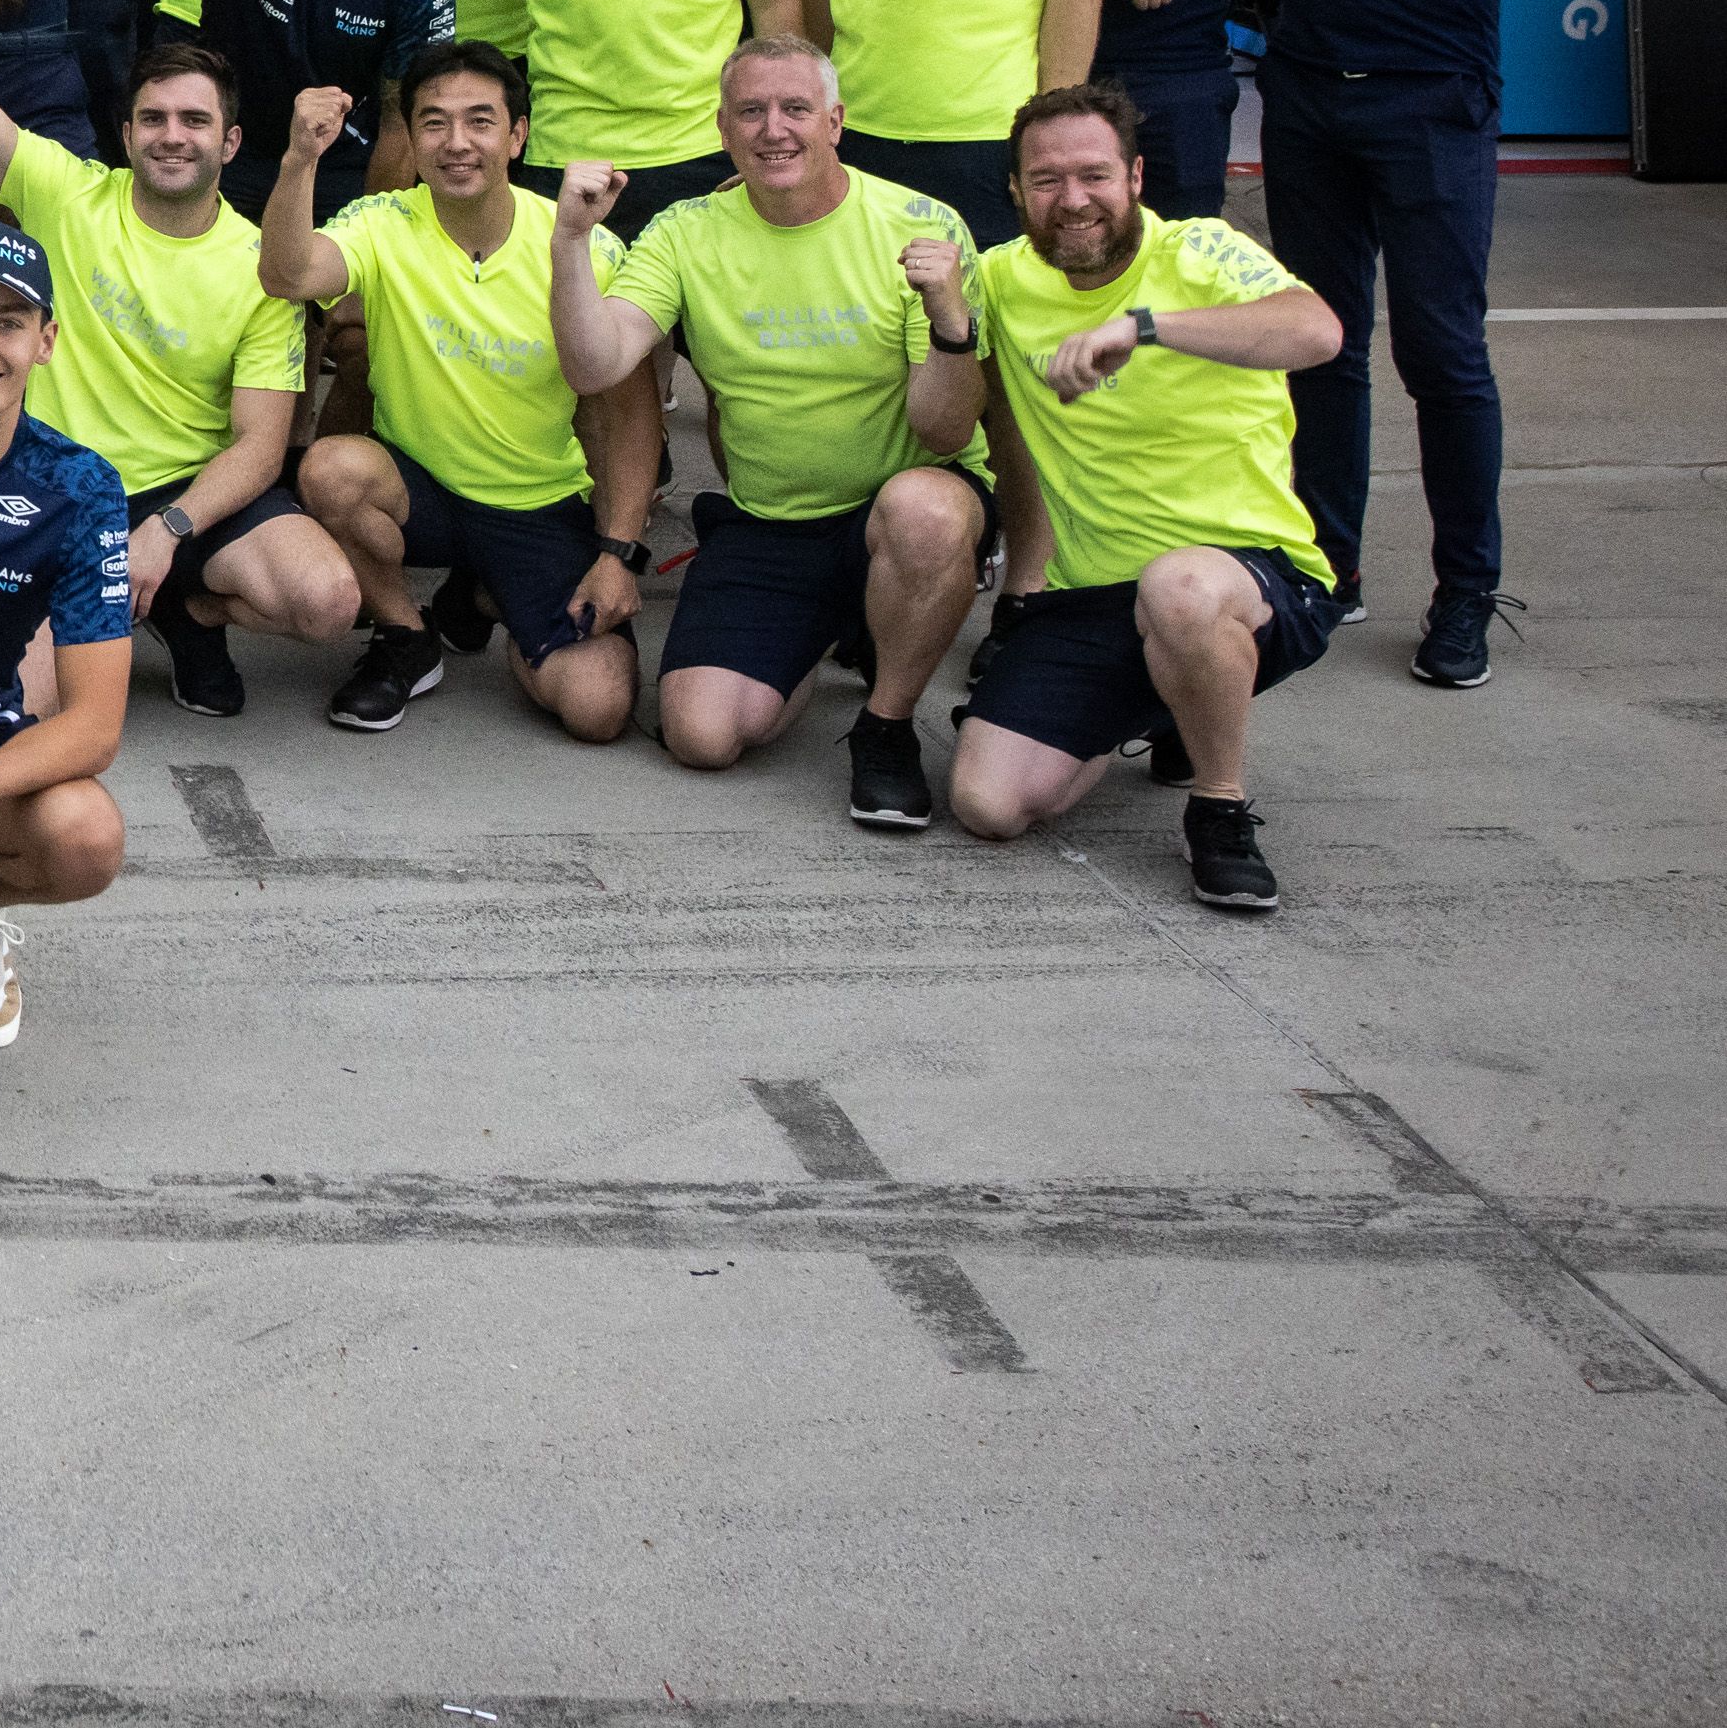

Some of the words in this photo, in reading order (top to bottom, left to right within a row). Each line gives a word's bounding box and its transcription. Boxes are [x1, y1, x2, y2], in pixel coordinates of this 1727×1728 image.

[336, 20, 377, 37] RACING
[91, 266, 187, 348] WILLIAMS
[92, 293, 167, 355] RACING
[743, 305, 869, 327] WILLIAMS
[425, 314, 544, 358] WILLIAMS
[436, 333, 526, 376] RACING
[758, 328, 858, 349] RACING
